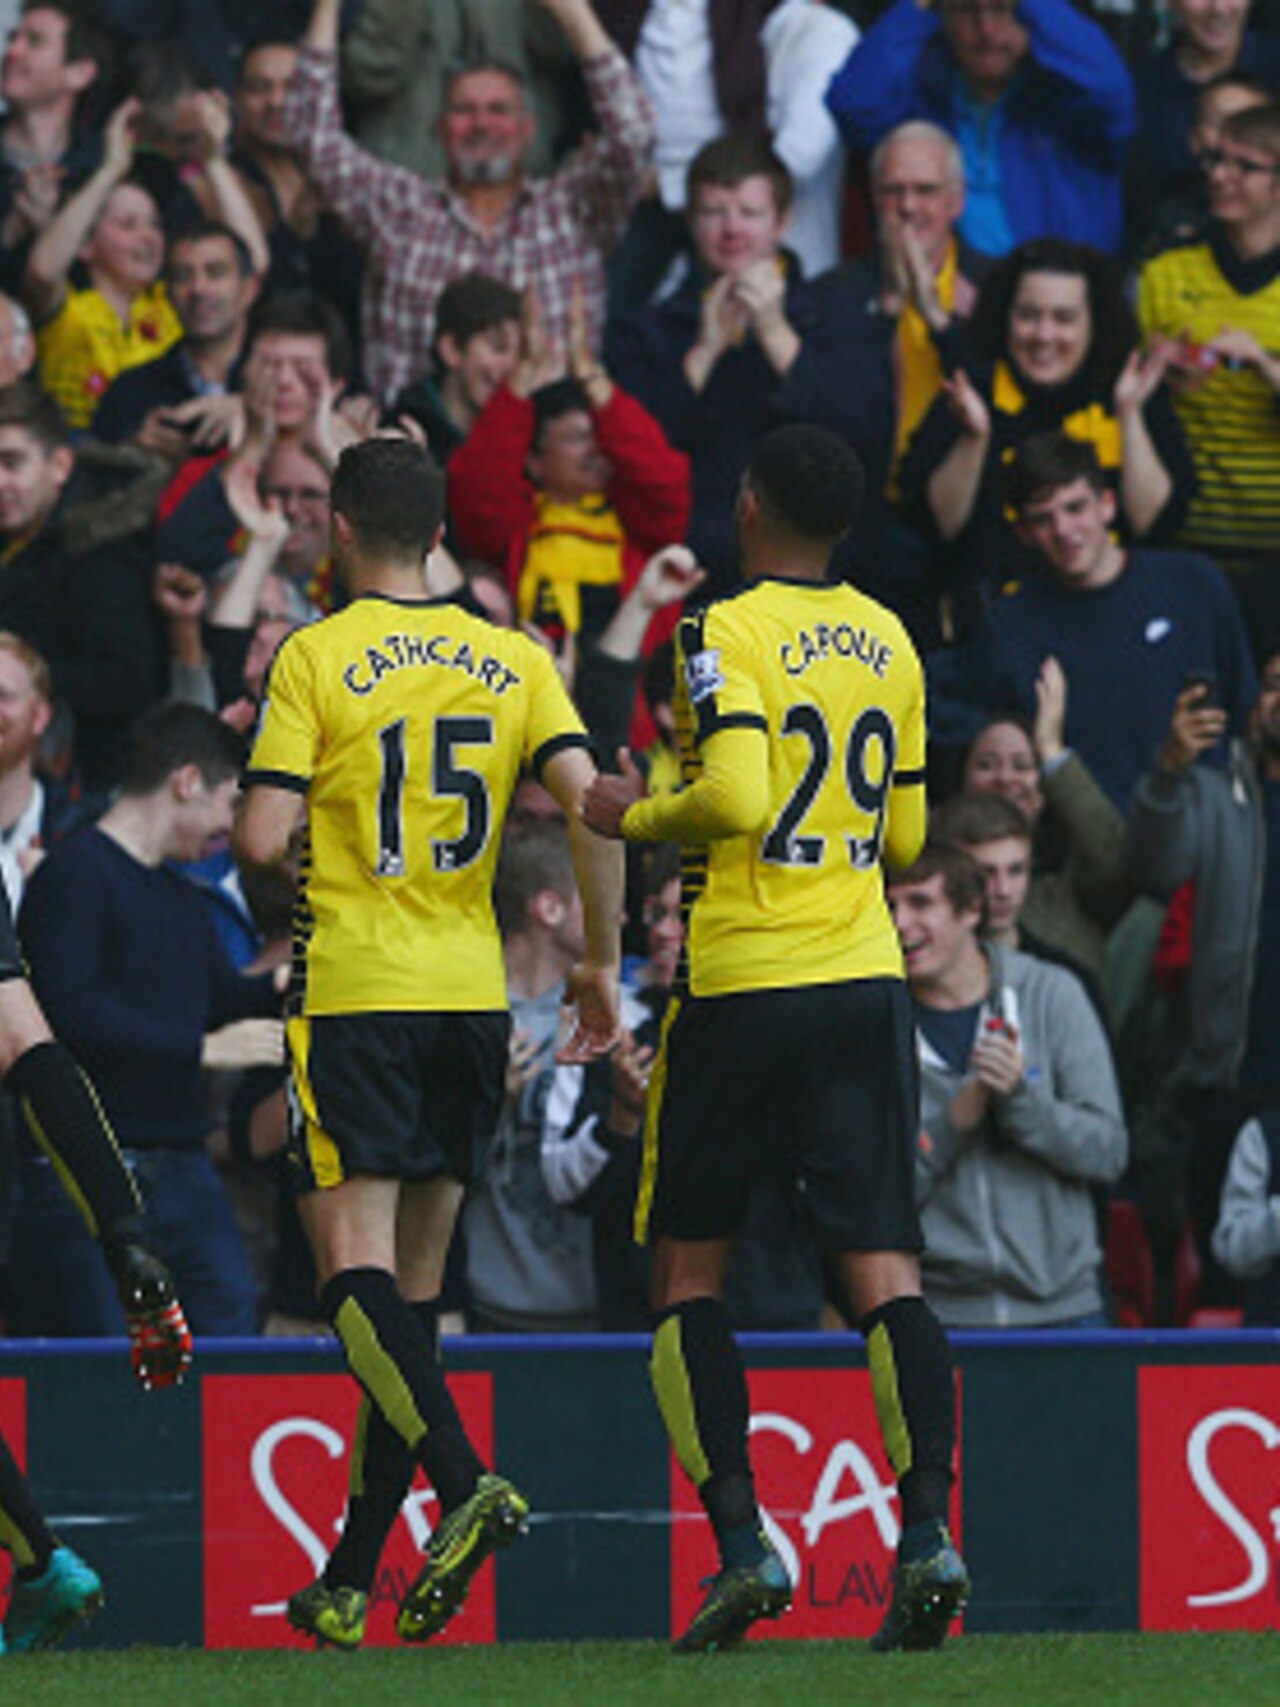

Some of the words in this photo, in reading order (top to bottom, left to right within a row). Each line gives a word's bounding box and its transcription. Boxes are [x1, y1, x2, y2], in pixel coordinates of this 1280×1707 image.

[342, 634, 521, 695] CATHCART
[780, 622, 893, 679] CAPOUE
[375, 715, 494, 876] 15
[761, 703, 897, 870] 29
